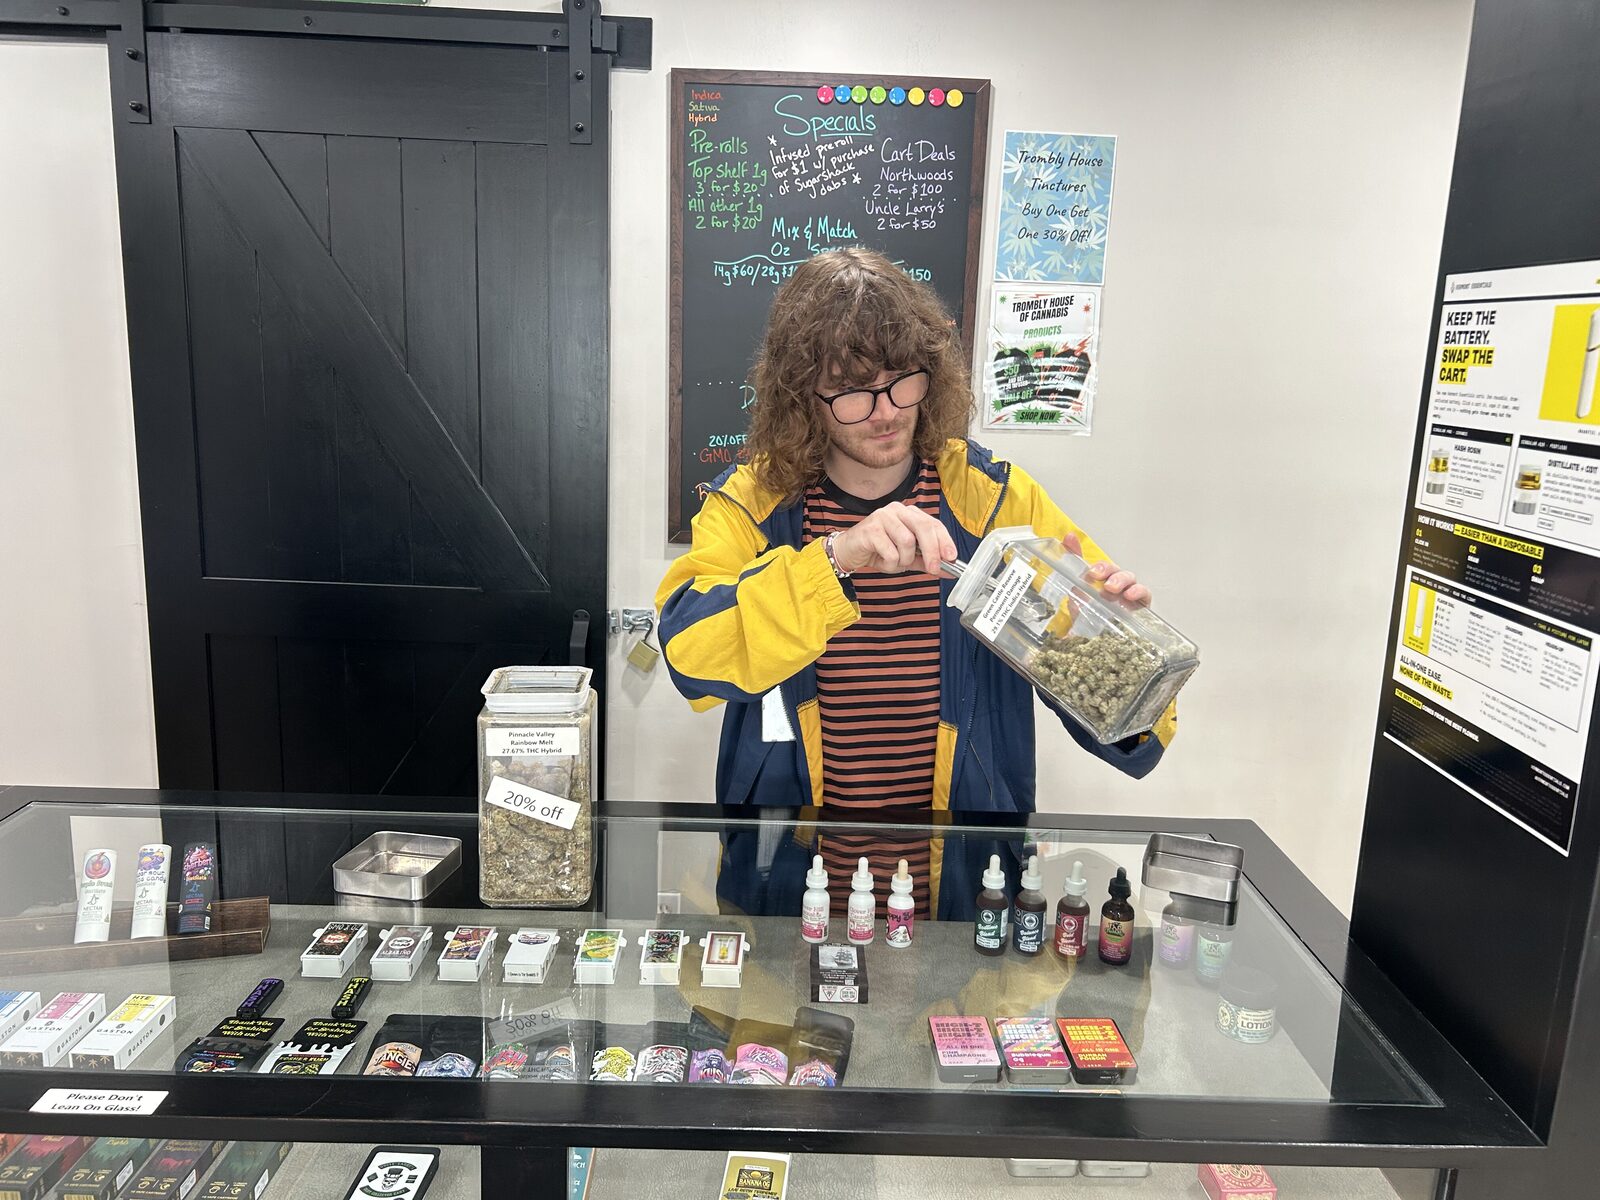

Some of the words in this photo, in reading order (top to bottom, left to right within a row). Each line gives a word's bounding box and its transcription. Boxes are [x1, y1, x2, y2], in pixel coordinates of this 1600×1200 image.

[692, 90, 721, 100] Indica
[688, 102, 720, 112] Sativa
[688, 114, 717, 127] Hybrid
[774, 94, 877, 142] Specials
[689, 129, 748, 154] Pre-rolls
[880, 137, 913, 163] Cart
[915, 140, 956, 163] Deals
[769, 144, 811, 165] Infused
[771, 166, 789, 180] for
[791, 160, 809, 177] $1
[813, 156, 826, 171] w/
[830, 143, 875, 170] purchase
[1018, 151, 1065, 169] Trombly
[1067, 152, 1104, 167] House
[688, 156, 713, 183] Top
[752, 163, 767, 187] 1g
[880, 167, 954, 181] Northwoods
[696, 181, 704, 194] 3
[711, 180, 730, 192] for
[732, 180, 758, 195] $20
[820, 178, 847, 197] dabs
[872, 184, 881, 197] 2
[887, 184, 907, 195] for
[911, 184, 943, 199] $100
[1030, 177, 1087, 193] Tinctures
[688, 199, 705, 212] All
[710, 199, 743, 213] other
[747, 196, 762, 221] 1g
[865, 200, 900, 215] Uncle
[905, 202, 945, 218] Larry's
[1022, 203, 1042, 219] Buy
[1046, 204, 1067, 218] One
[1070, 205, 1091, 218] Get
[695, 216, 706, 229] 2
[711, 216, 729, 228] for
[732, 213, 757, 232] $20
[877, 218, 886, 231] 2
[889, 219, 910, 230] for
[912, 218, 937, 231] $50
[771, 217, 799, 241] Mix
[804, 217, 812, 250] &
[818, 216, 858, 243] Match
[1017, 227, 1039, 240] One
[1042, 229, 1066, 242] 30%
[1069, 228, 1093, 243] Off!
[903, 268, 932, 282] 150
[1012, 297, 1049, 313] TROMBLY
[1049, 295, 1075, 309] HOUSE
[1019, 311, 1030, 322] OF
[1030, 307, 1069, 321] CANNABIS
[1446, 311, 1472, 326] KEEP
[1475, 310, 1496, 325] THE
[1023, 325, 1062, 339] PRODUCTS
[1441, 349, 1470, 364] SWAP
[1472, 349, 1494, 364] THE
[1439, 368, 1467, 383] CART.
[1020, 411, 1039, 420] SHOP
[1040, 411, 1056, 419] NOW
[1418, 514, 1429, 524] HOW
[1435, 518, 1454, 533] WORKS
[1460, 527, 1481, 540] EASIER
[1481, 532, 1497, 546] THAN
[1498, 537, 1503, 546] A
[1503, 538, 1542, 557] DISPOSABLE
[982, 603, 995, 619] Green
[992, 588, 1004, 604] Castle
[1001, 569, 1016, 589] Reserve
[989, 595, 1009, 623] Permanent
[1006, 575, 1022, 596] Damage
[1001, 606, 1011, 618] THC
[1009, 592, 1021, 608] Indica
[1019, 573, 1032, 592] Hybrid
[1400, 655, 1427, 675] ALL-IN-ONE
[1428, 668, 1442, 682] EASE.
[1400, 665, 1414, 679] NONE
[1413, 673, 1421, 681] OF
[1421, 676, 1432, 689] THE
[1432, 682, 1452, 700] WASTE.
[535, 731, 556, 739] Valley
[503, 790, 538, 813] 20%
[540, 806, 565, 821] off
[336, 982, 358, 1007] HASH
[1241, 1020, 1272, 1030] LOTION
[60, 1025, 83, 1049] GASTON
[132, 1028, 153, 1052] GASTON
[66, 1093, 106, 1102] Please
[108, 1094, 144, 1102] Don't
[51, 1103, 80, 1112] Lean
[83, 1104, 101, 1112] On
[104, 1104, 141, 1113] Glass!
[739, 1178, 762, 1187] BANANA
[762, 1180, 771, 1189] OG
